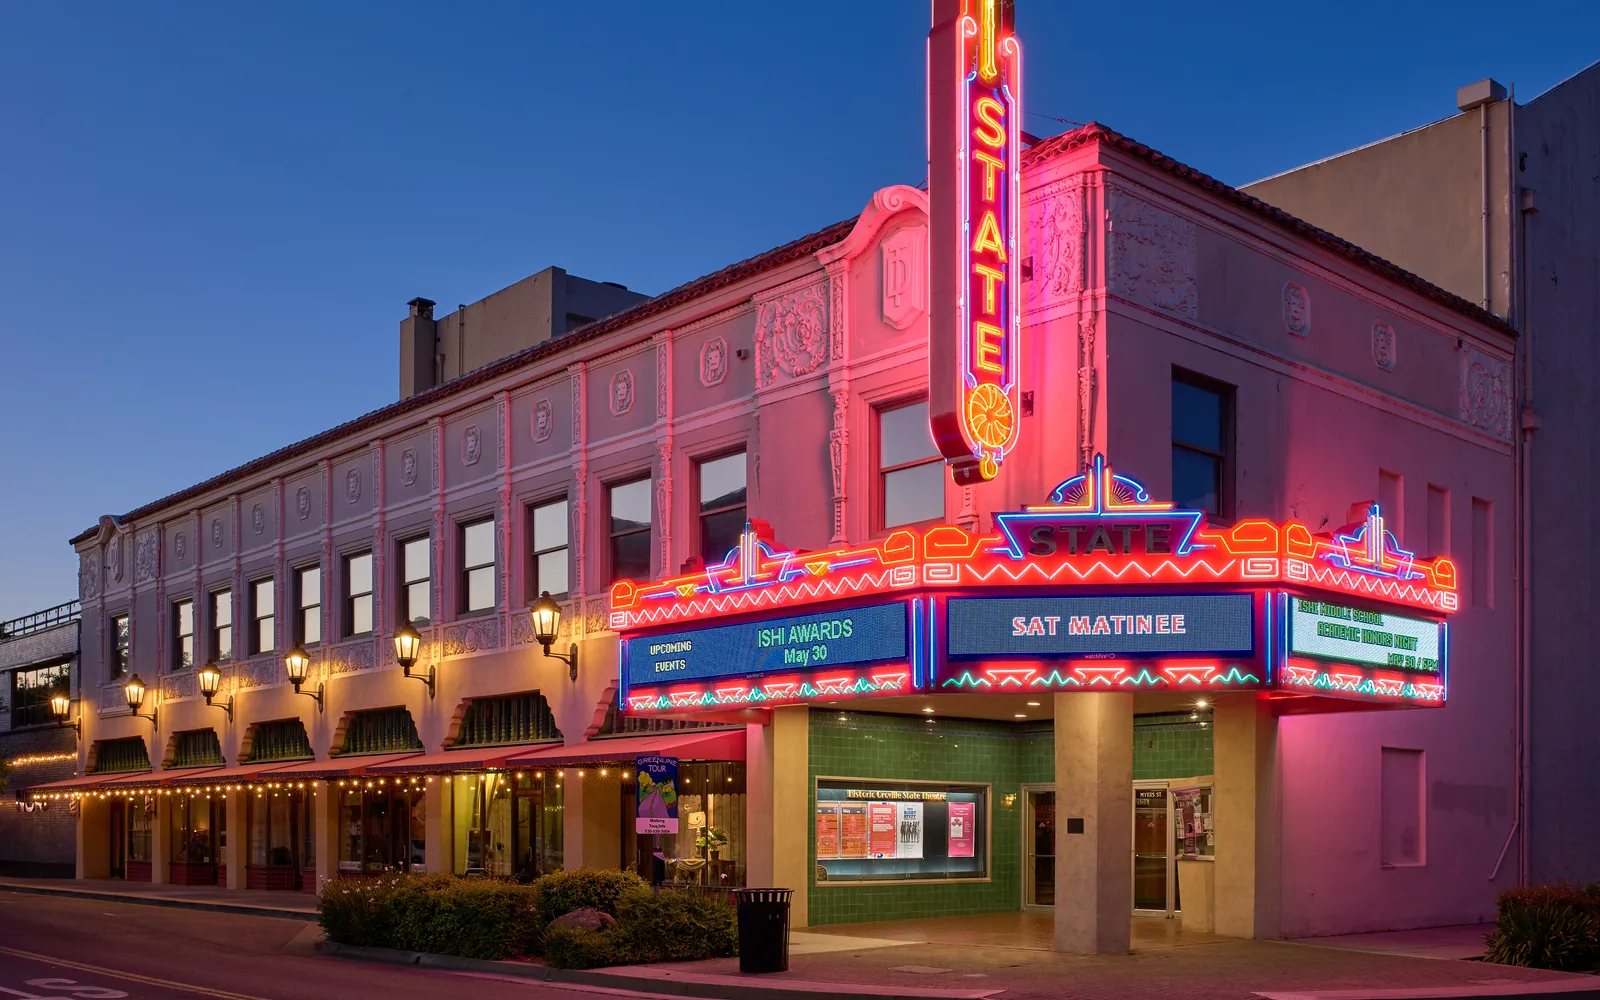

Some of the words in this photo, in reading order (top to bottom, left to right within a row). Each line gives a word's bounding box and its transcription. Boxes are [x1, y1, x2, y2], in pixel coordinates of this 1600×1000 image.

[973, 98, 1007, 374] STATE
[1028, 523, 1172, 557] STATE
[1298, 600, 1319, 615] ISHI
[1320, 602, 1352, 621] MIDDLE
[1352, 608, 1384, 626] SCHOOL
[758, 627, 785, 648] ISHI
[788, 618, 853, 645] AWARDS
[1012, 616, 1060, 636] SAT
[1068, 614, 1187, 636] MATINEE
[1317, 621, 1361, 642] ACADEMIC
[1361, 628, 1393, 647] HONORS
[1393, 633, 1418, 651] NIGHT
[650, 640, 692, 656] UPCOMING
[784, 648, 810, 666] May
[812, 644, 828, 661] 30
[655, 659, 686, 673] EVENTS
[1387, 652, 1404, 667] MAY
[1405, 655, 1415, 668] 30
[1421, 657, 1439, 672] 6PM
[638, 757, 677, 767] GREENLINE
[648, 764, 667, 773] TOUR
[847, 789, 876, 799] Historic
[876, 790, 902, 799] Oroville
[902, 791, 921, 800] State
[921, 791, 947, 801] Theatre
